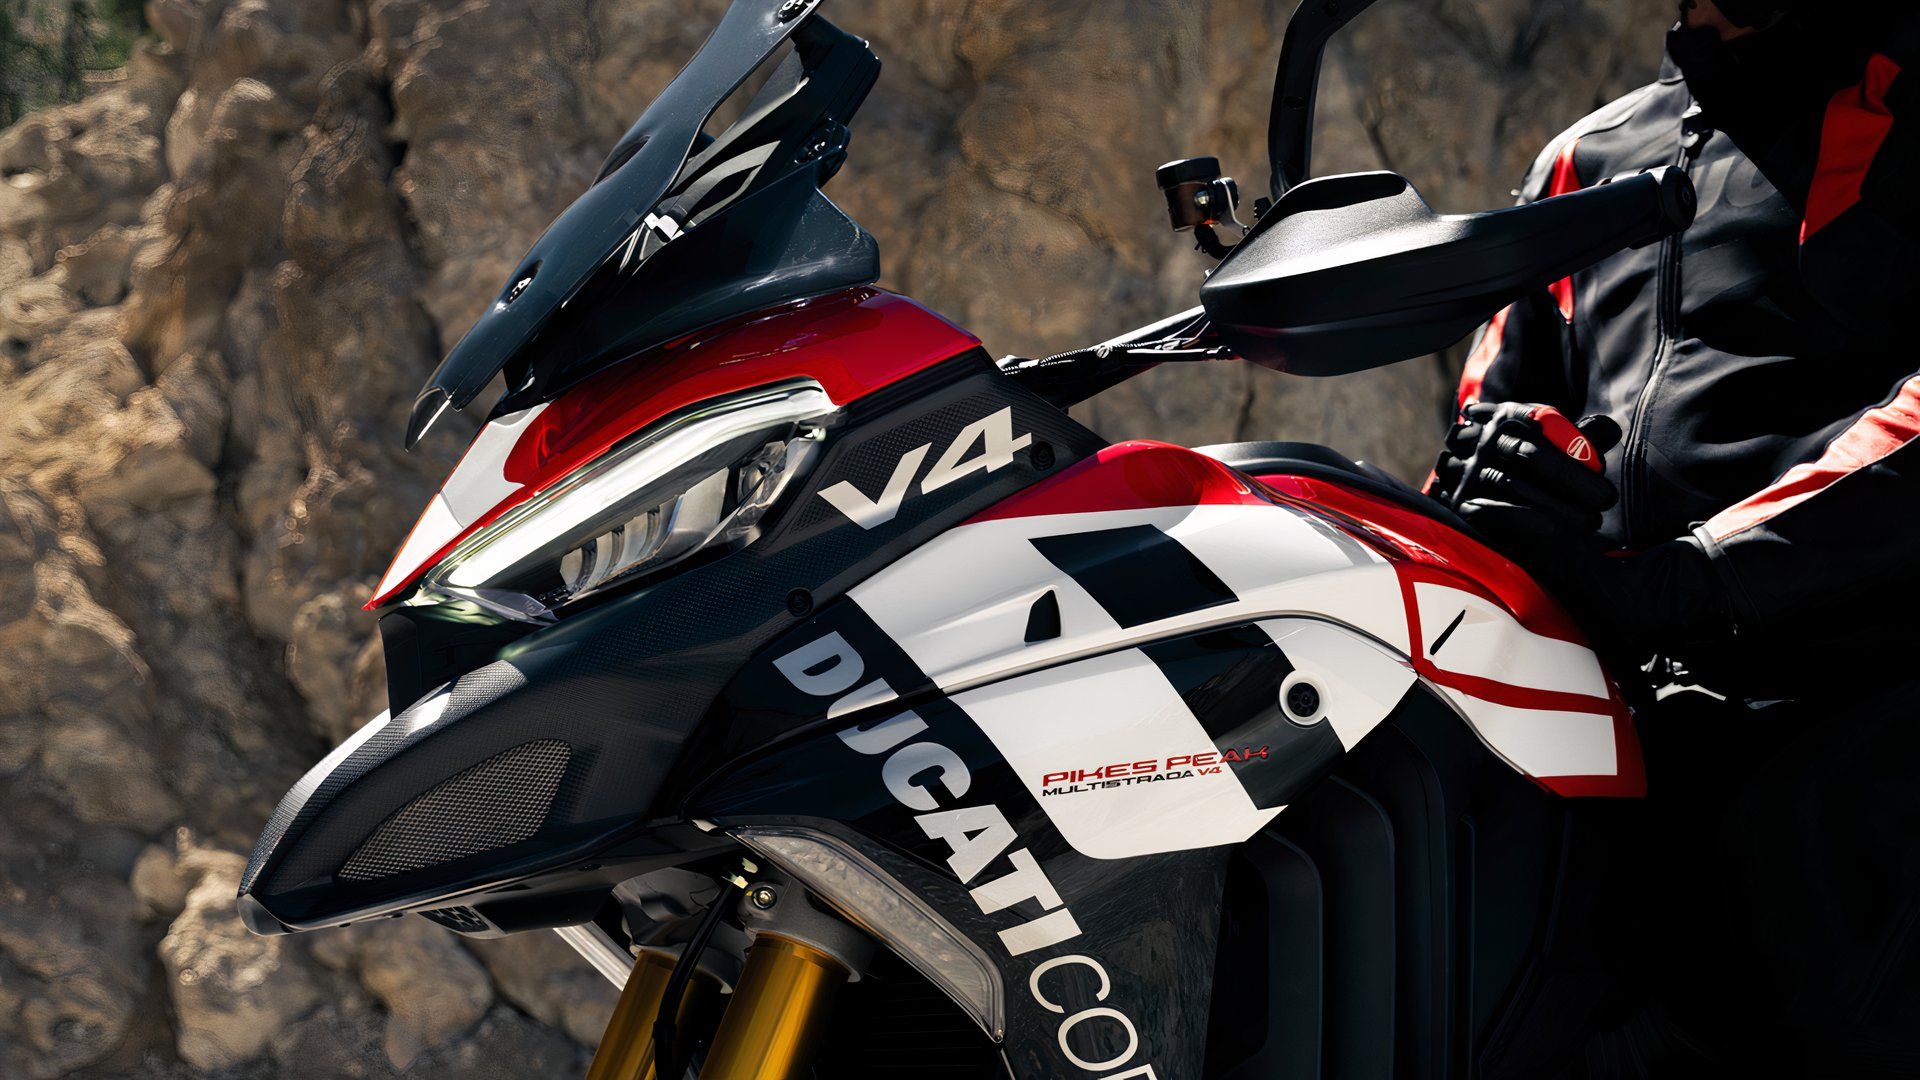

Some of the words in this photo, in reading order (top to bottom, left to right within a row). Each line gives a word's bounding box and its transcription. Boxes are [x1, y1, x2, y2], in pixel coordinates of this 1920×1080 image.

[817, 406, 1032, 530] V4
[1042, 759, 1158, 787] PIKES
[1166, 745, 1270, 771] PEAK
[1042, 770, 1194, 797] MULTISTRADA
[1197, 765, 1223, 777] V4
[772, 630, 1083, 957] DUCATI
[1029, 954, 1158, 1080] CO
